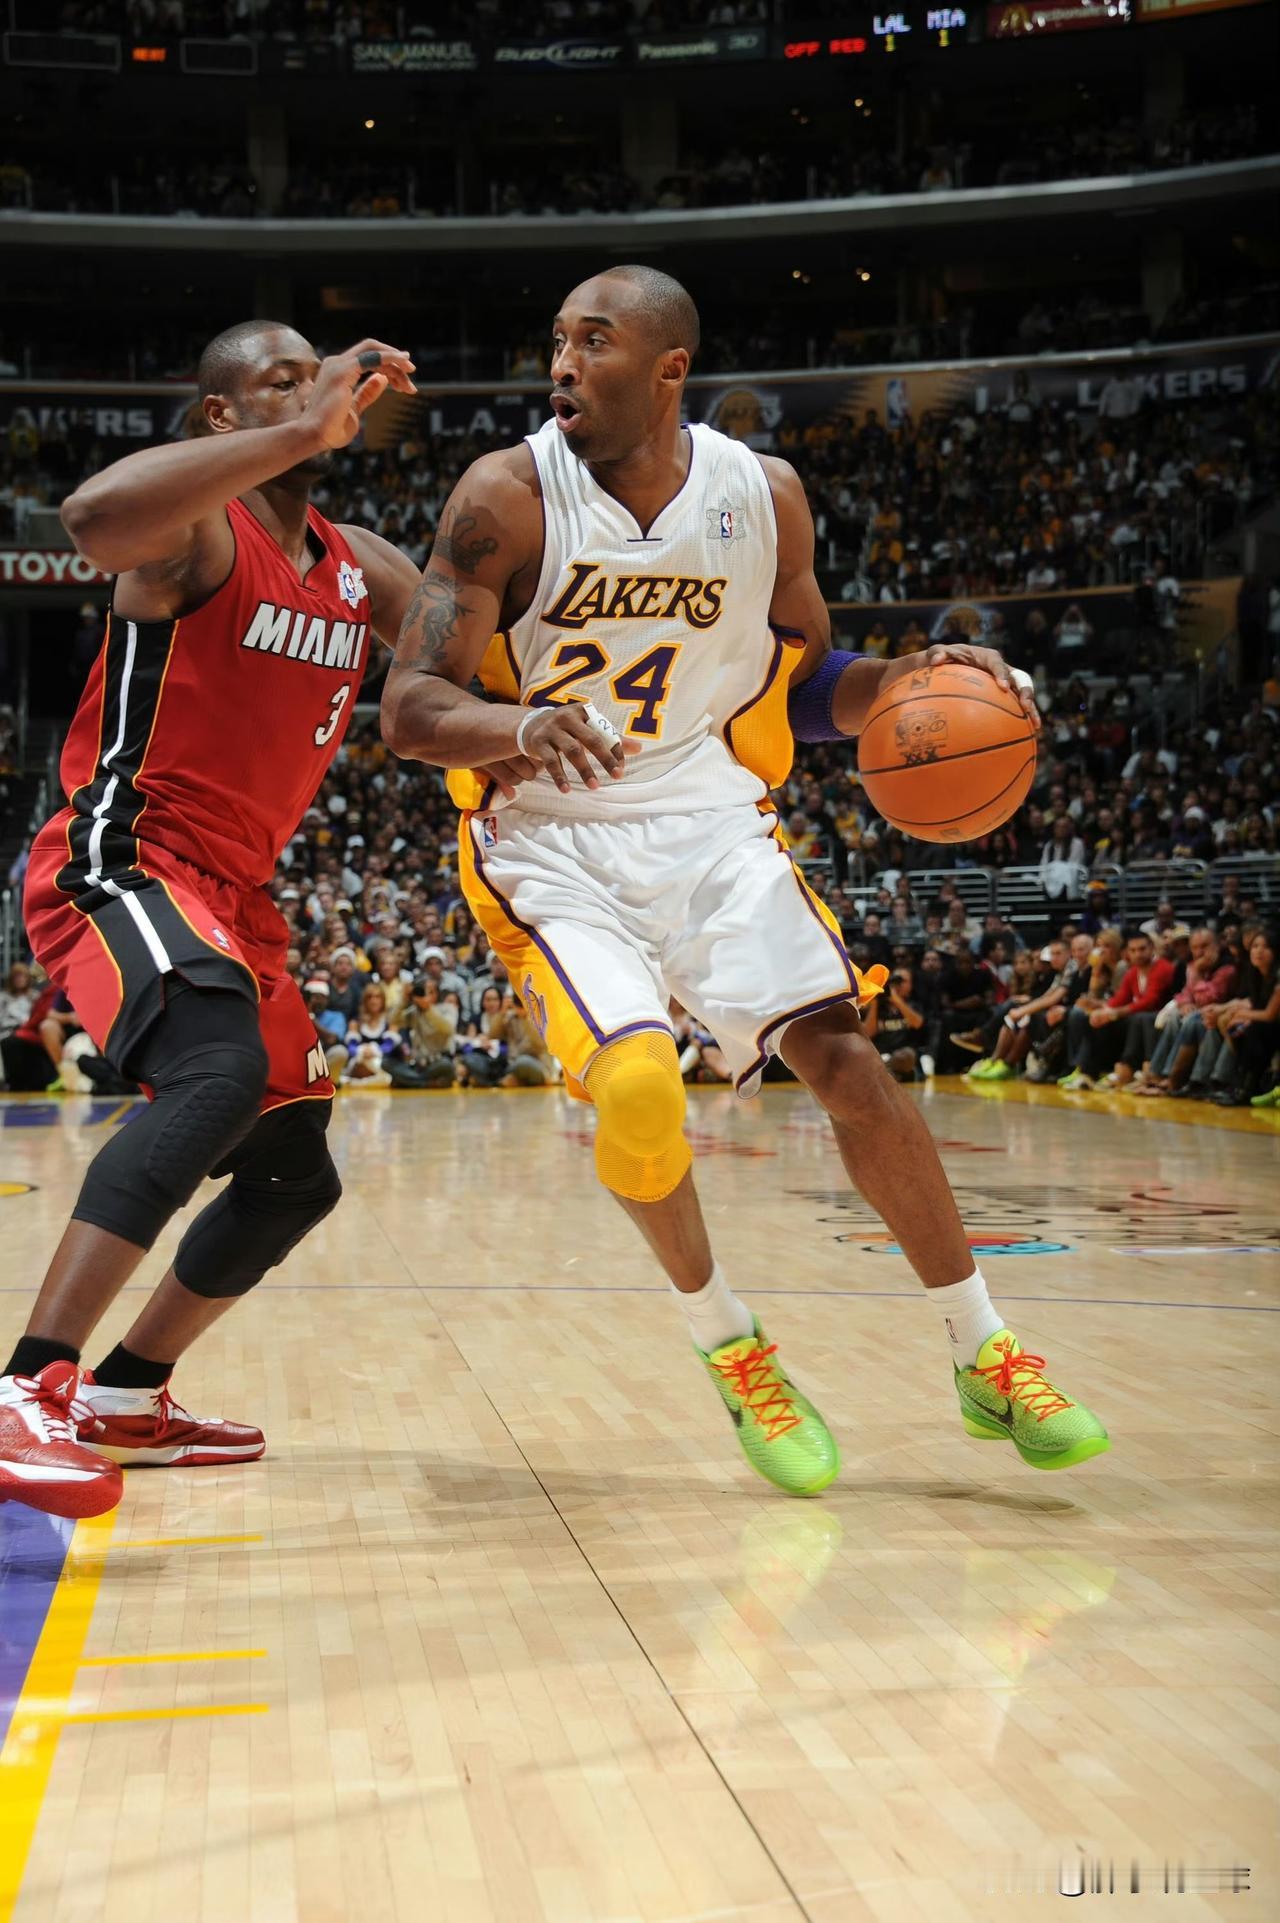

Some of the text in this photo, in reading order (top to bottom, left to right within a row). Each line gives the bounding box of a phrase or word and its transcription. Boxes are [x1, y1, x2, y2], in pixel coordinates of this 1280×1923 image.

[873, 8, 966, 34] LAL MIA
[353, 42, 476, 61] SAN MANUEL
[638, 41, 718, 60] Panasonic
[884, 29, 950, 52] 1 1
[1077, 364, 1247, 407] LKERS
[0, 406, 153, 437] AKERS
[0, 552, 111, 582] TOYO
[541, 561, 727, 630] LAKERS
[242, 602, 367, 671] MIAMI
[522, 639, 683, 740] 24
[313, 684, 350, 746] 3
